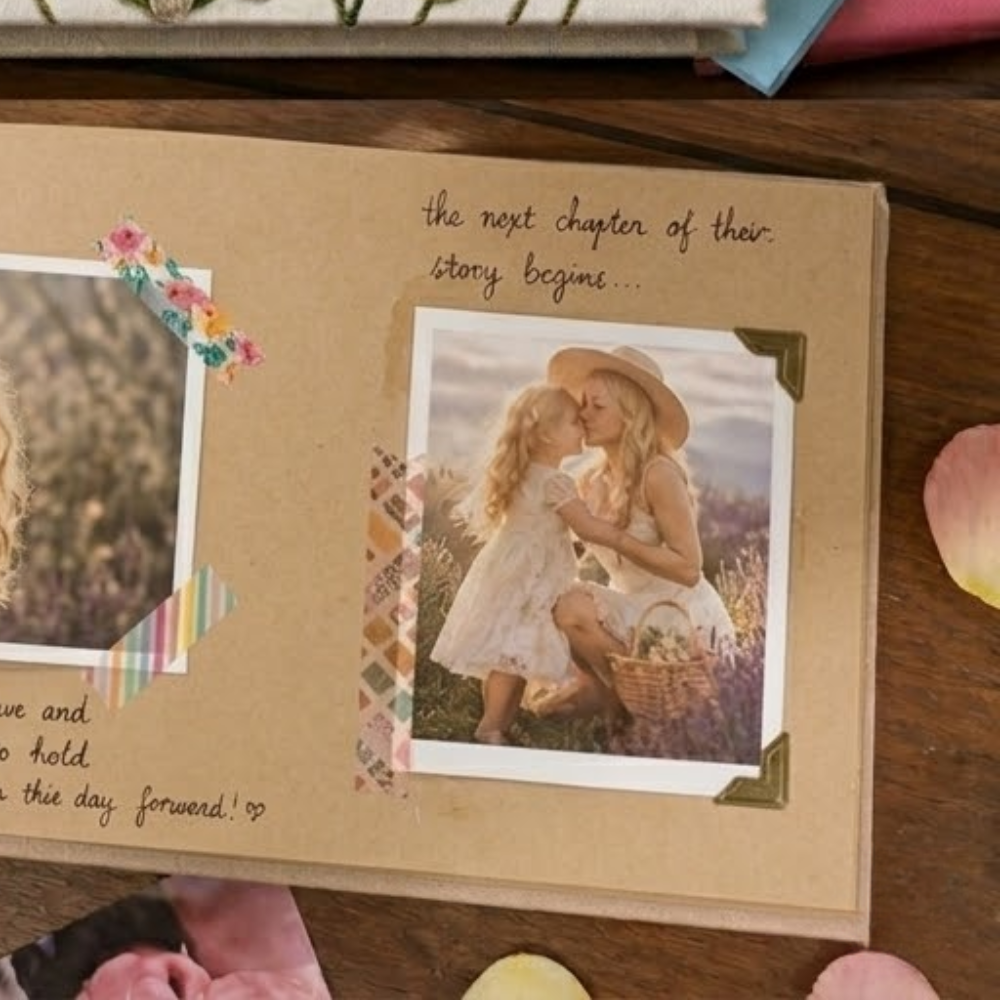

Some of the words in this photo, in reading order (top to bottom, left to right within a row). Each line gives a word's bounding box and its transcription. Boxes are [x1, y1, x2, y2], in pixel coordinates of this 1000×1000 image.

[421, 188, 465, 228] the
[480, 205, 536, 239] next
[555, 194, 649, 251] chapter
[665, 208, 697, 254] of
[429, 253, 504, 301] story
[41, 694, 92, 725] and
[73, 783, 118, 828] day
